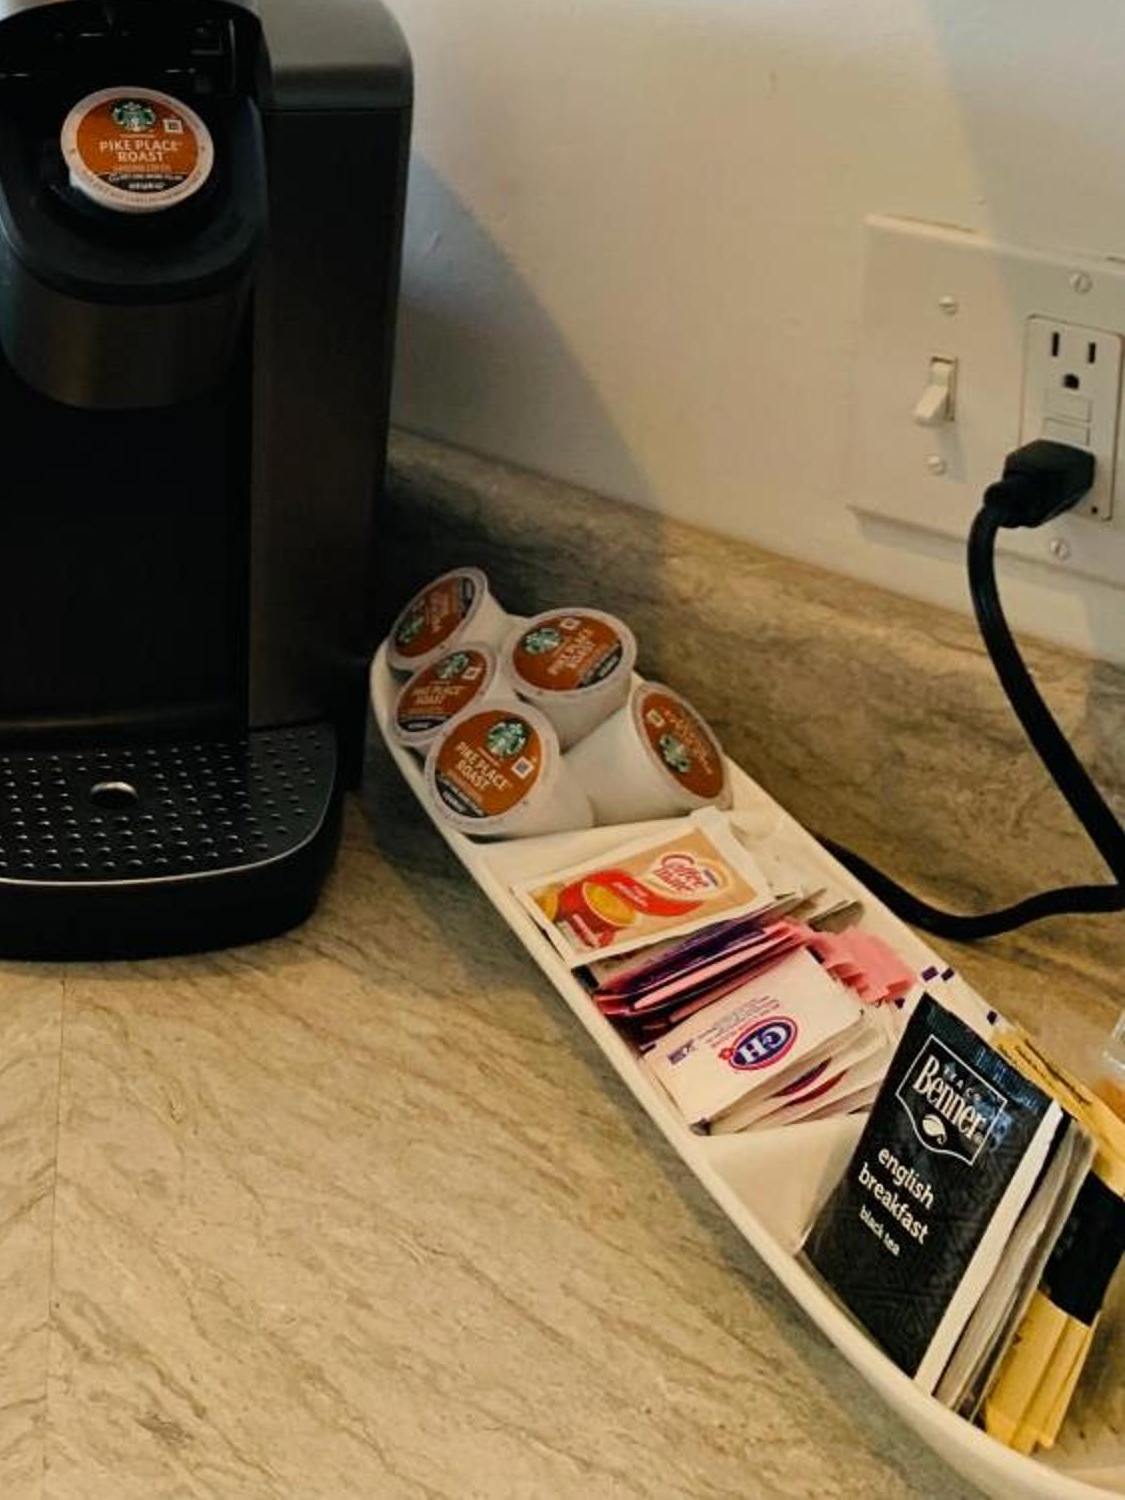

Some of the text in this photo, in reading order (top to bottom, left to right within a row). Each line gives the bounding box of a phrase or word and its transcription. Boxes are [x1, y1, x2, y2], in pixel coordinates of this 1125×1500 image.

[98, 139, 179, 153] PIKE PLACE
[118, 151, 164, 162] ROAST
[457, 758, 491, 791] ROAST
[476, 758, 508, 791] PLACE
[913, 1054, 987, 1140] Benner
[878, 1147, 934, 1210] english
[859, 1161, 929, 1245] breakfast
[859, 1204, 900, 1256] black tea
